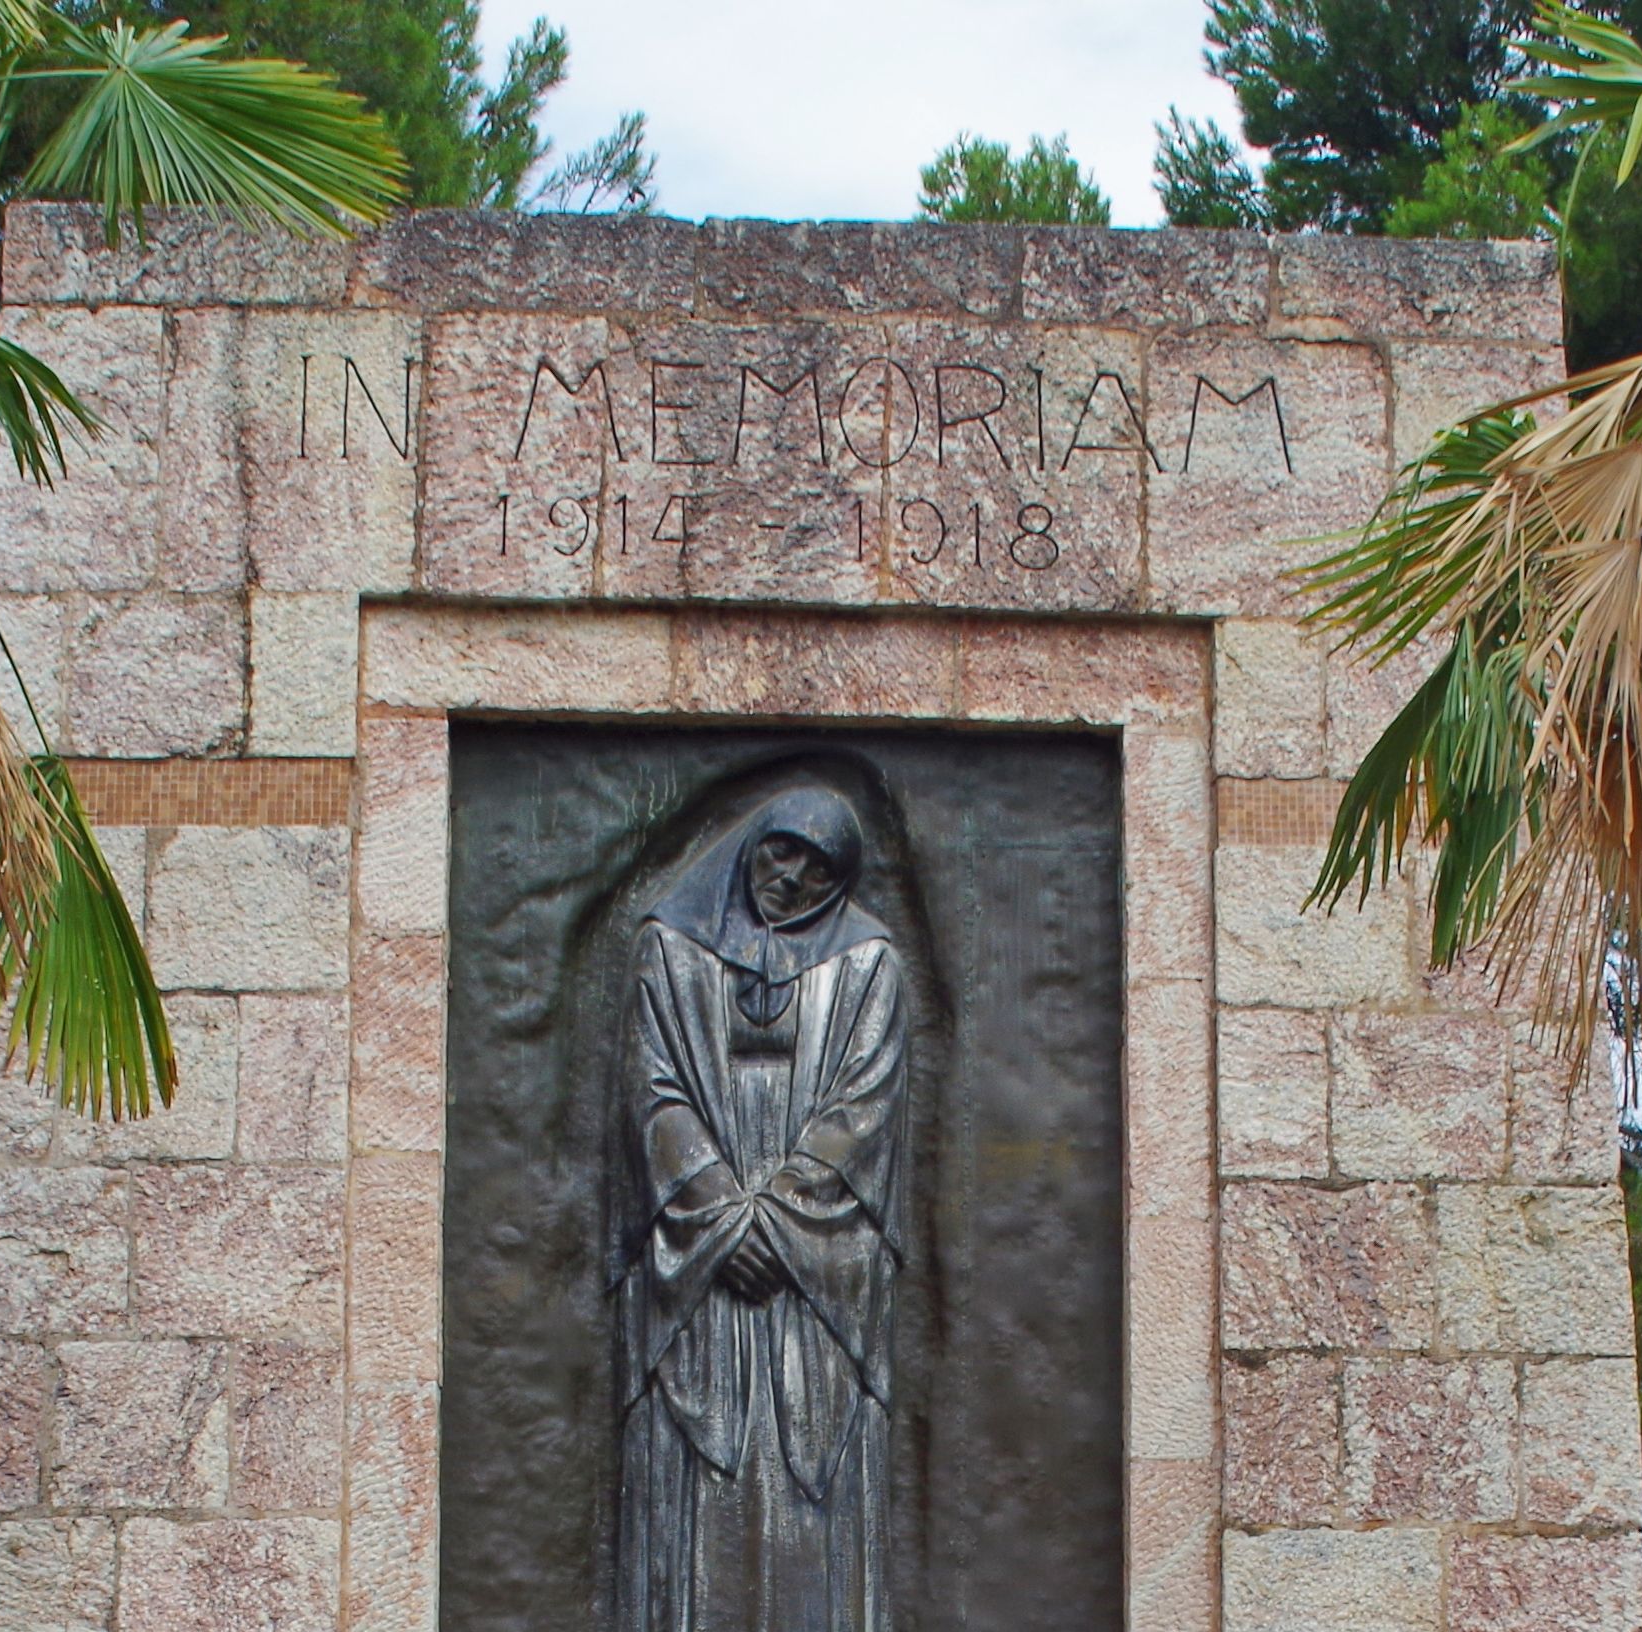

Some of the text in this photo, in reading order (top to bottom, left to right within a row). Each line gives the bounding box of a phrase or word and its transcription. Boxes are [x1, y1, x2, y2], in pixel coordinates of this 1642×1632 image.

[297, 356, 1293, 475] IN MEMORIAM
[495, 493, 688, 557] 1914
[855, 497, 1061, 571] 1918
